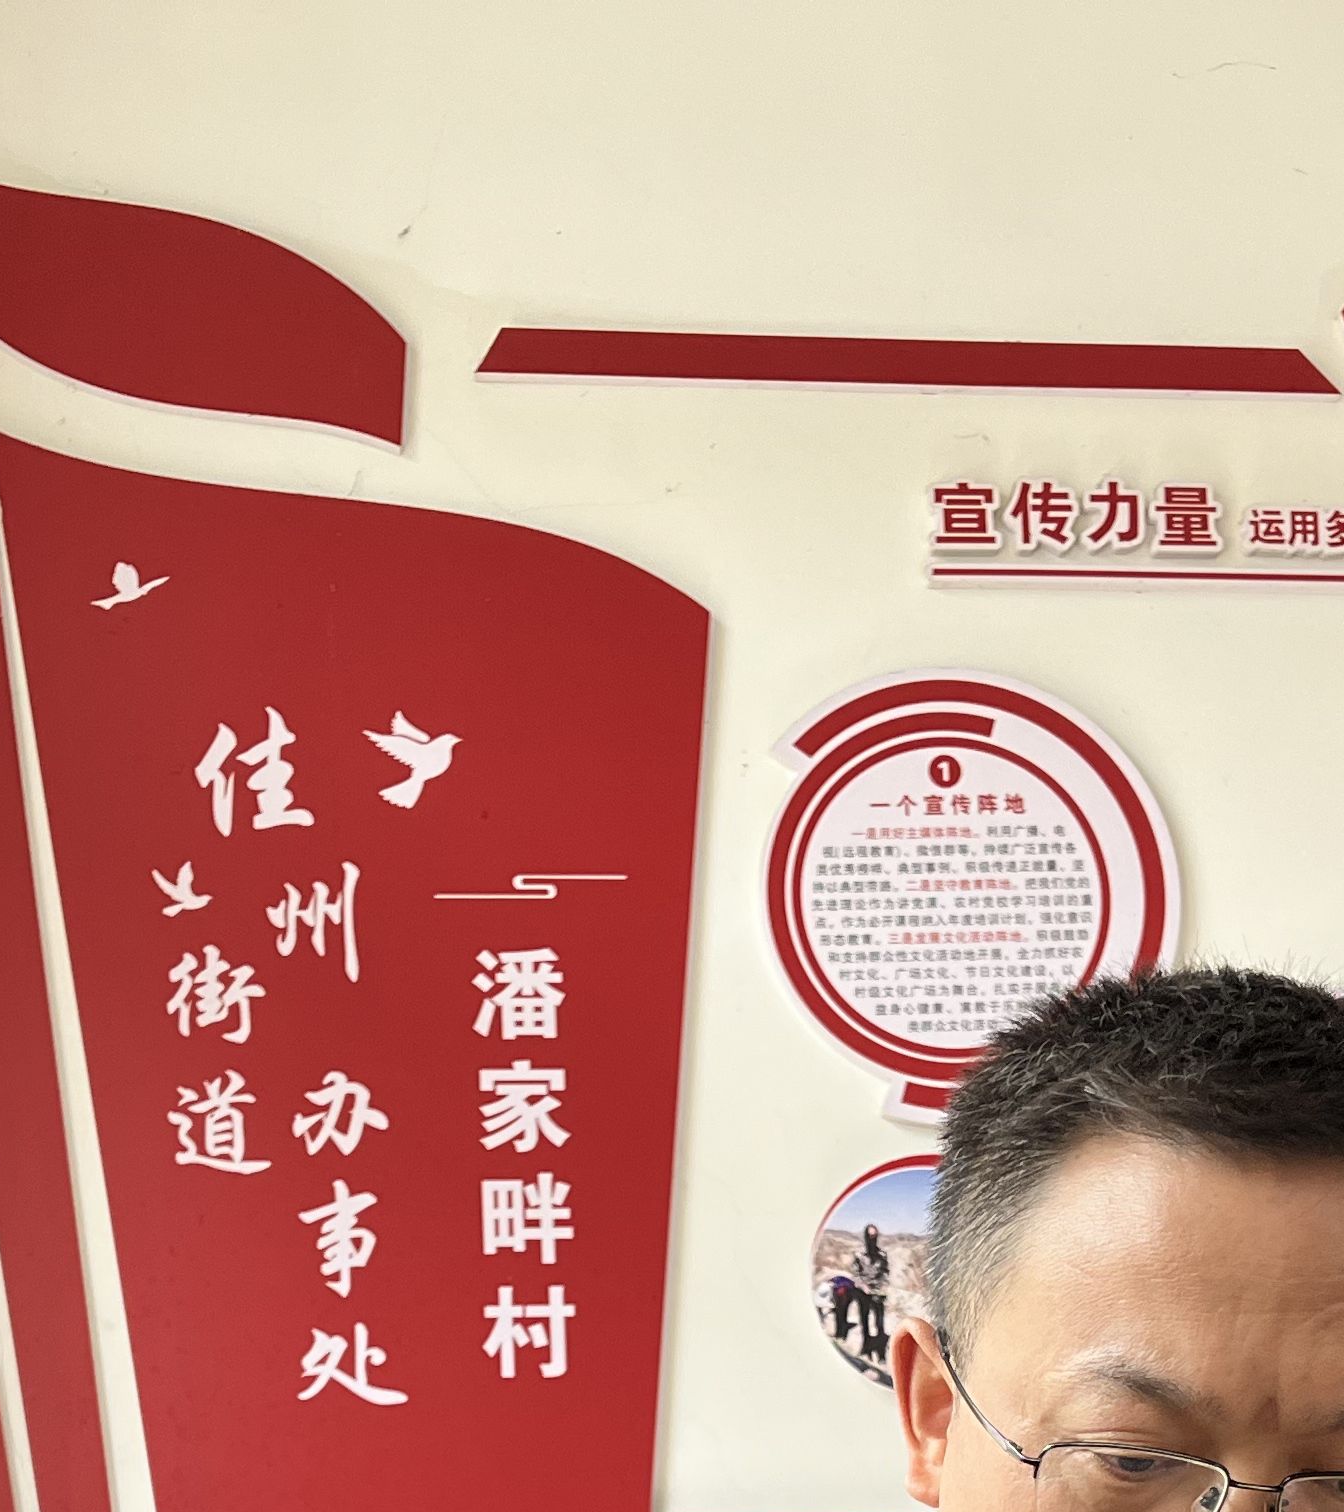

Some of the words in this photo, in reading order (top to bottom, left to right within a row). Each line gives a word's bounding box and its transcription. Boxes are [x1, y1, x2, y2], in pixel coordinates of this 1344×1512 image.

[932, 481, 1218, 548] 宣传力量
[869, 794, 1027, 816] 一个宣传阵地
[165, 945, 272, 1177] 街道
[290, 1070, 409, 1407] 办事处
[472, 948, 576, 1379] 潘家畔村
